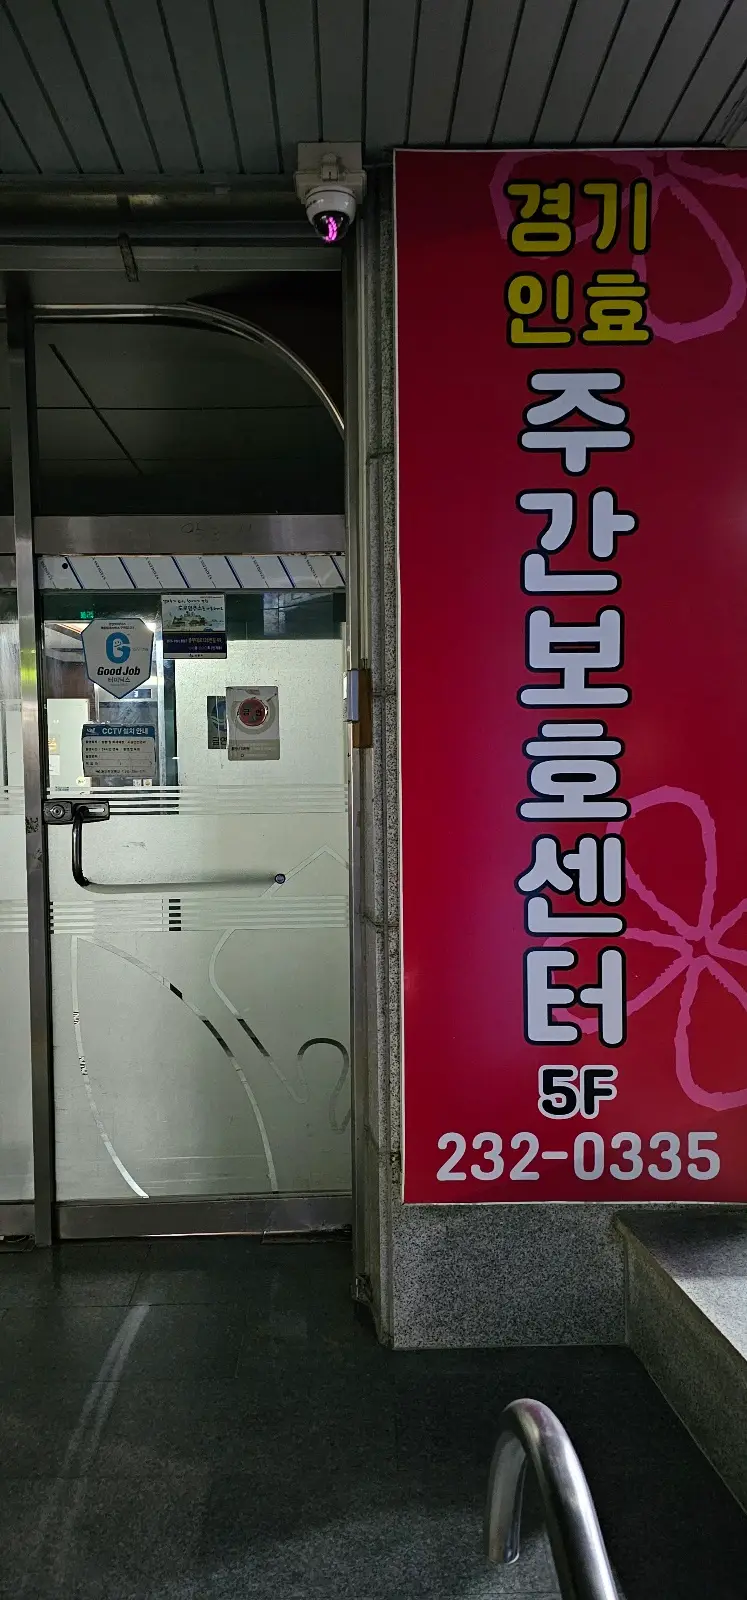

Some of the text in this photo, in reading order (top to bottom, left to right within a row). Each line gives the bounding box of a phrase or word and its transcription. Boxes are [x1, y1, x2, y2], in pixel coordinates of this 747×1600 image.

[504, 179, 652, 255] 경기
[504, 270, 653, 348] 인효
[97, 666, 141, 676] Good Job
[102, 727, 123, 735] CCTV
[136, 727, 149, 735] 안내
[516, 369, 639, 1048] 주간보호센터
[538, 1064, 618, 1120] 5F
[436, 1131, 721, 1182] 232-0335
